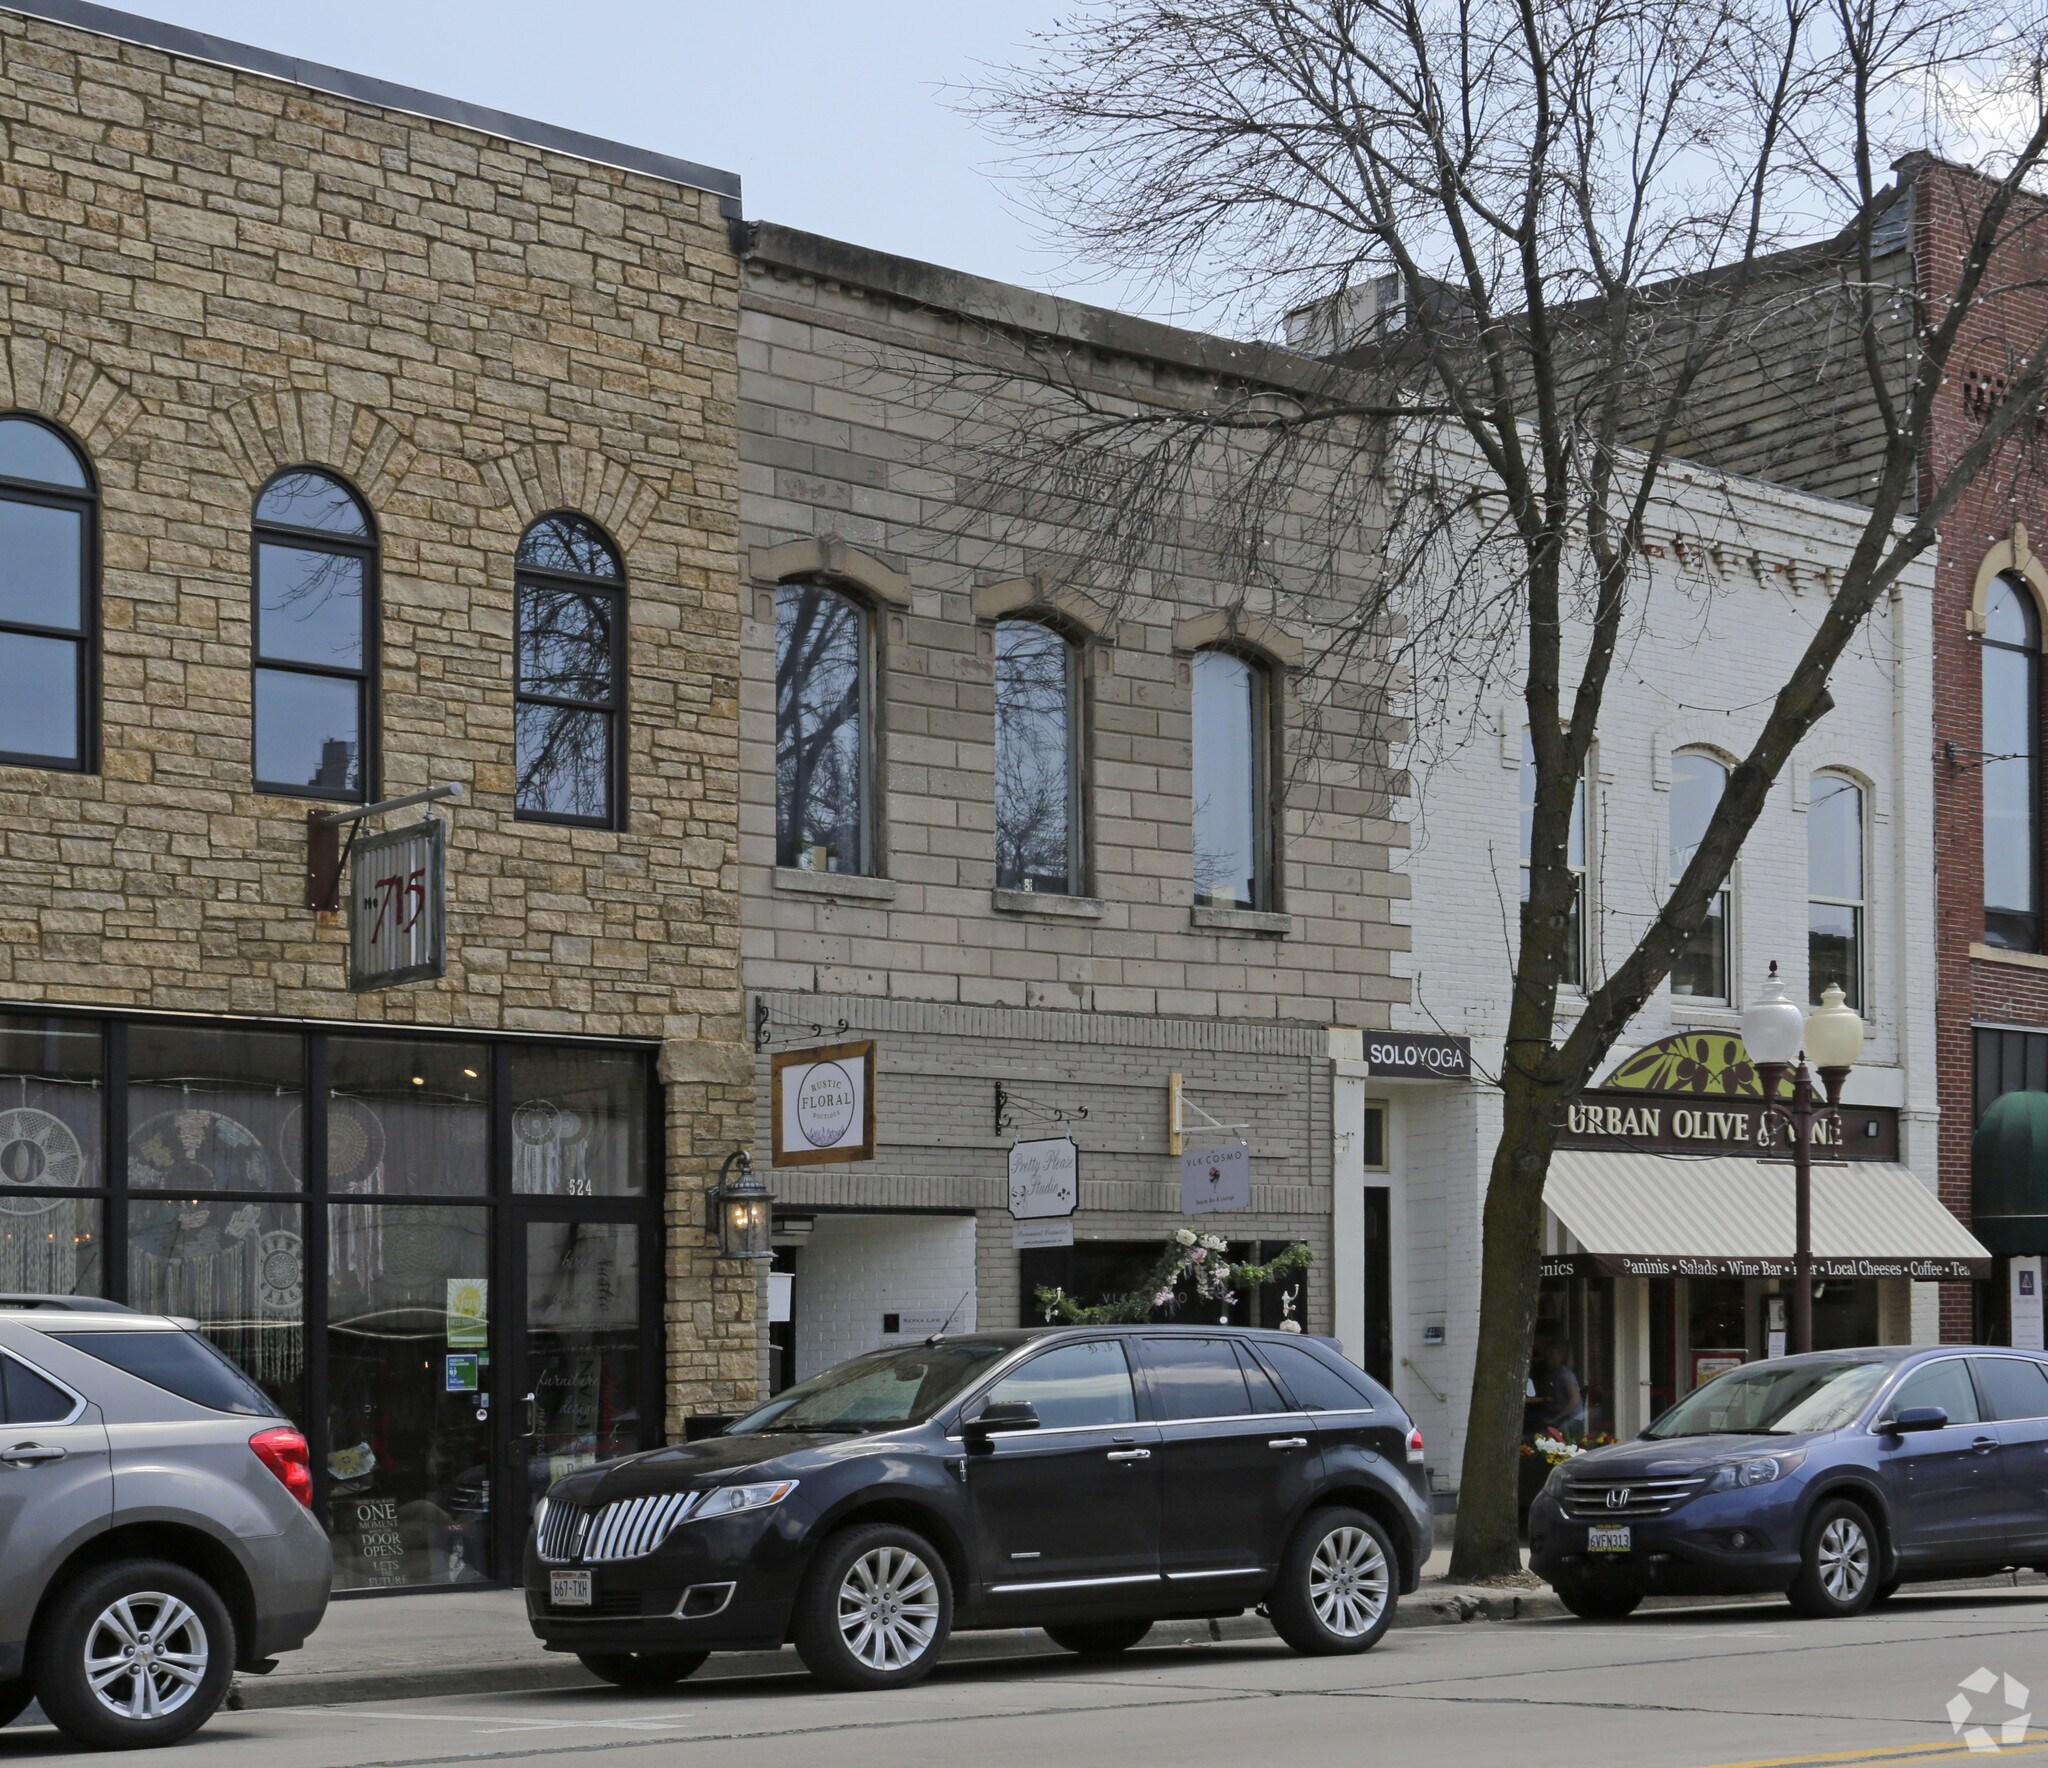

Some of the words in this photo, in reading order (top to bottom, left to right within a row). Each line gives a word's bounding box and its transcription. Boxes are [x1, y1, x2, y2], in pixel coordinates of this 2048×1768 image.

[371, 867, 425, 944] 715
[811, 1080, 842, 1092] RUSTIC
[802, 1092, 852, 1109] FLORAL
[813, 1109, 840, 1119] BOUTIQUE
[1567, 1103, 1661, 1136] URBAN
[1672, 1109, 1750, 1141] OLIVE
[1011, 1152, 1041, 1176] Pretty
[1043, 1149, 1074, 1171] Please
[1206, 1151, 1242, 1164] COSMO
[569, 1179, 592, 1196] 524
[1027, 1175, 1059, 1196] Studio
[1623, 1258, 1670, 1274] Paninis
[1680, 1258, 1718, 1276] Salads
[1727, 1260, 1759, 1276] Wine
[1761, 1261, 1781, 1276] Bar
[1827, 1260, 1857, 1275] Local
[1859, 1260, 1902, 1276] Cheeses
[1911, 1260, 1943, 1276] Coffee
[357, 1503, 398, 1521] ONE
[359, 1520, 399, 1531] MOMENT
[361, 1532, 402, 1545] DOOR
[1590, 1534, 1629, 1548] 6VFN313
[363, 1544, 404, 1558] OPENS
[373, 1561, 399, 1572] LETS
[368, 1575, 408, 1587] FUTURE
[554, 1580, 588, 1598] 667-TXH
